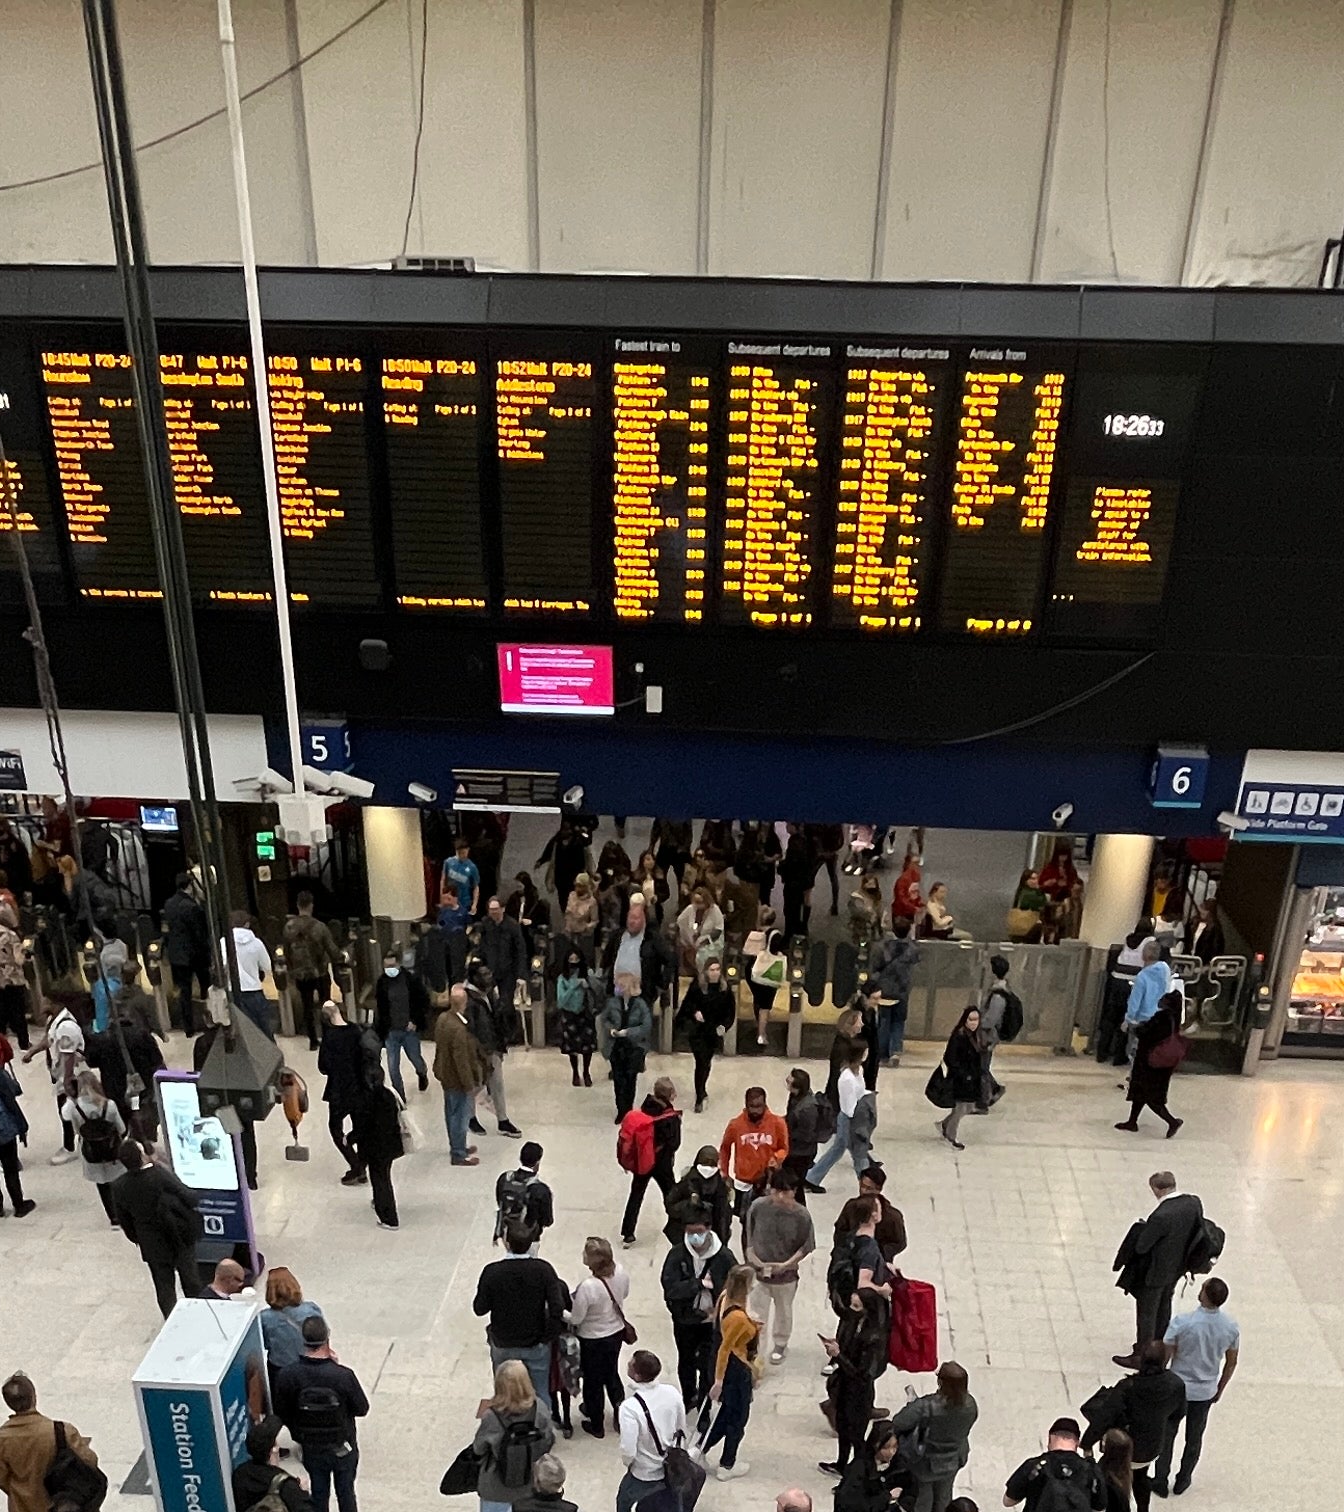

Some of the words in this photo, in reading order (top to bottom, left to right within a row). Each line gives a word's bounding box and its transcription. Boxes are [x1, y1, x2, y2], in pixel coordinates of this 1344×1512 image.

[1005, 350, 1027, 361] from
[311, 735, 328, 762] 5
[1172, 766, 1192, 795] 6
[168, 1402, 194, 1470] Station
